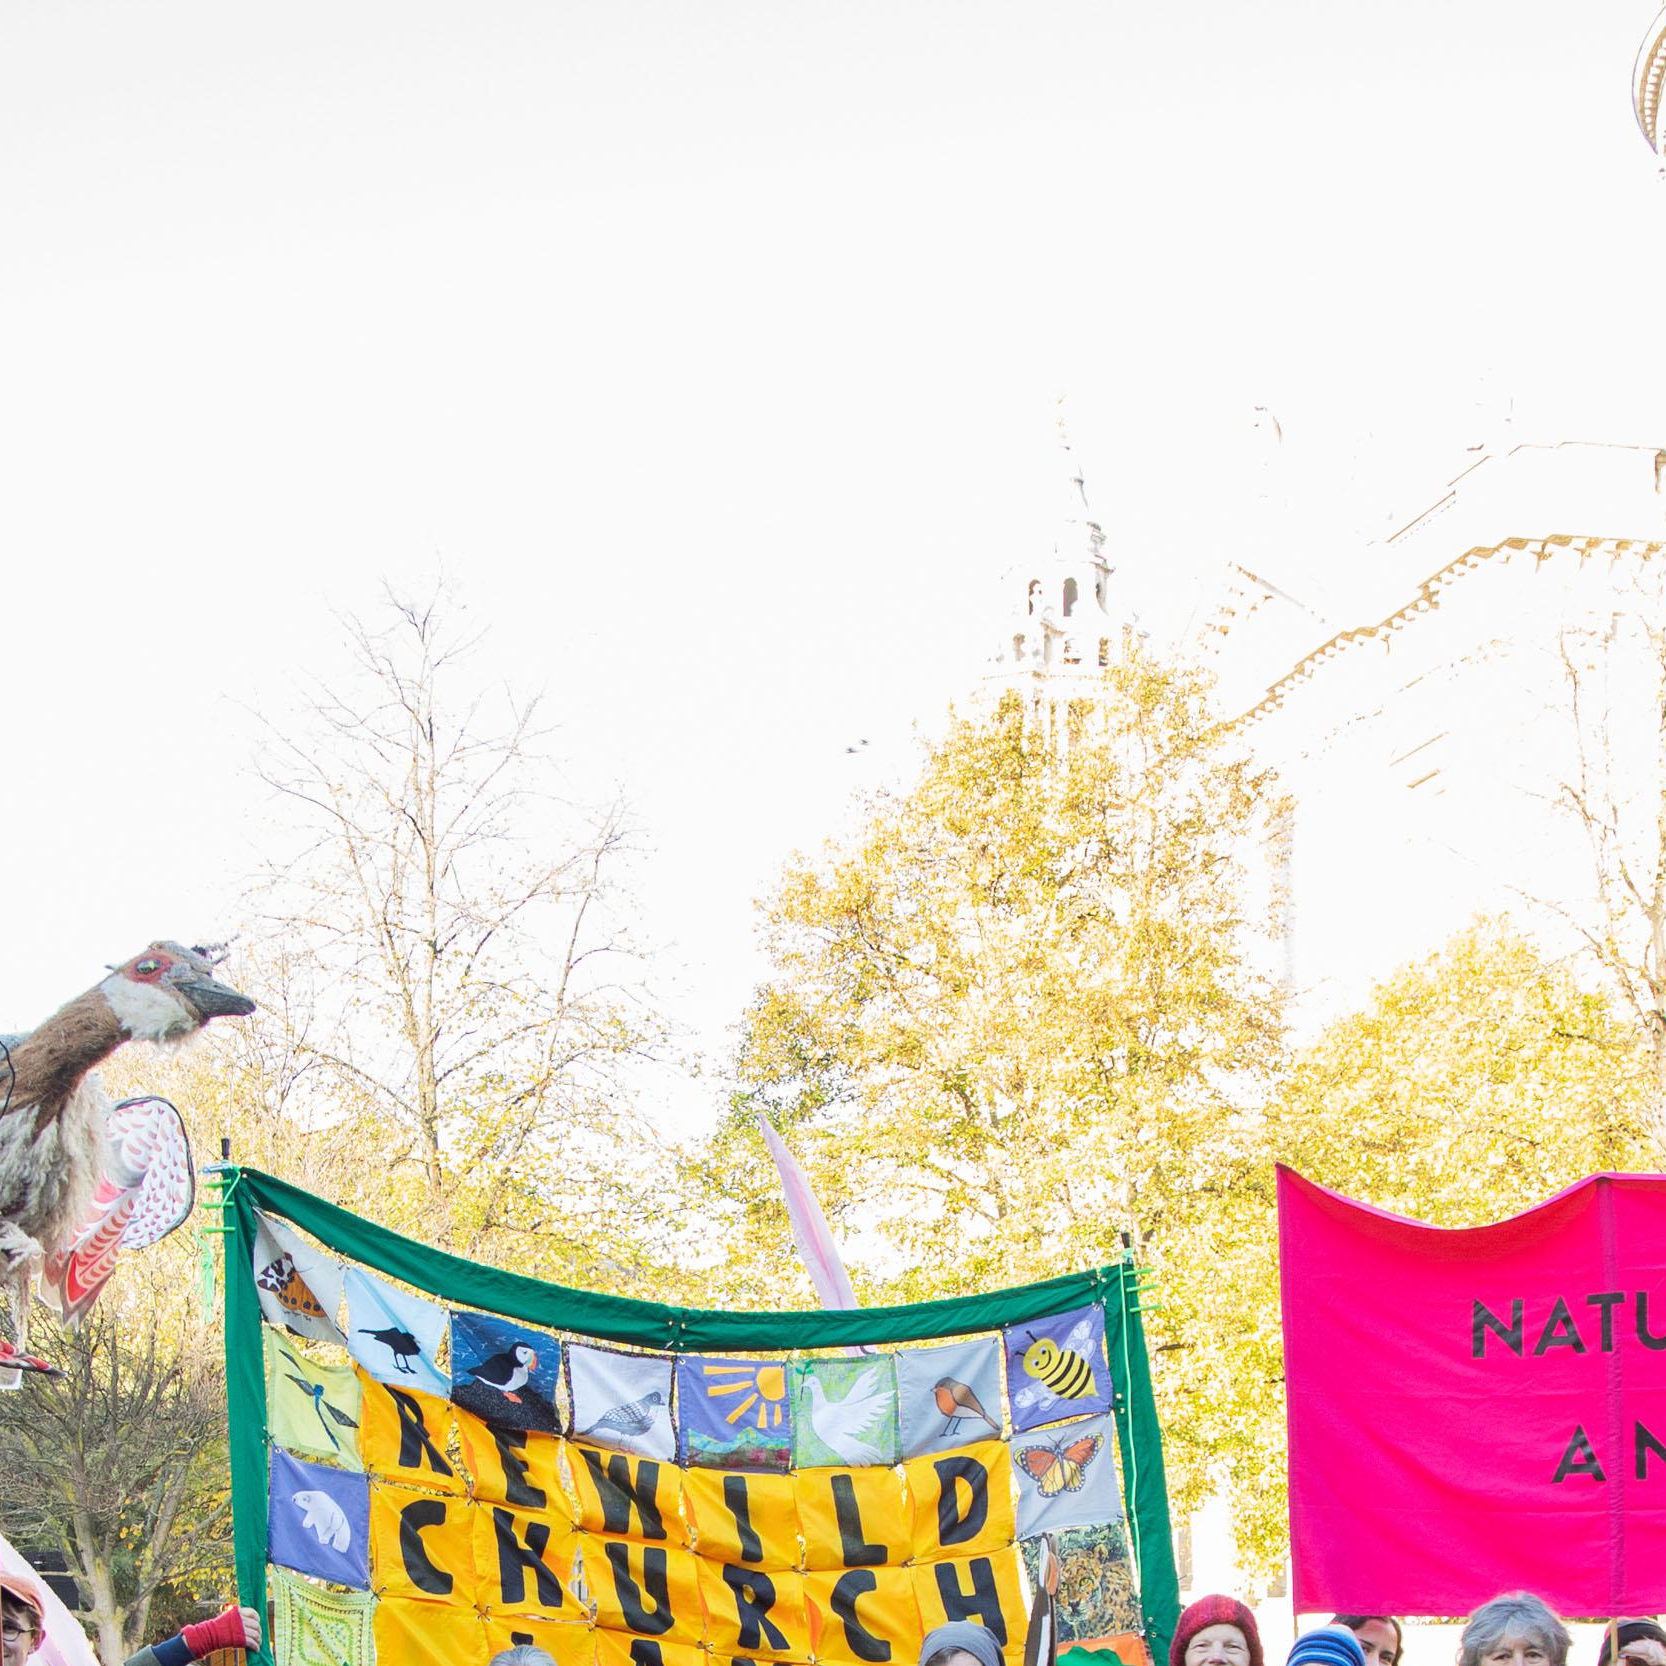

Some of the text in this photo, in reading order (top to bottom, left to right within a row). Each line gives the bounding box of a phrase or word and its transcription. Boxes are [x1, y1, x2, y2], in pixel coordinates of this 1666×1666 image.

[383, 1383, 989, 1567] REWILD
[1551, 1425, 1607, 1484] A
[400, 1499, 1008, 1662] CHURCH
